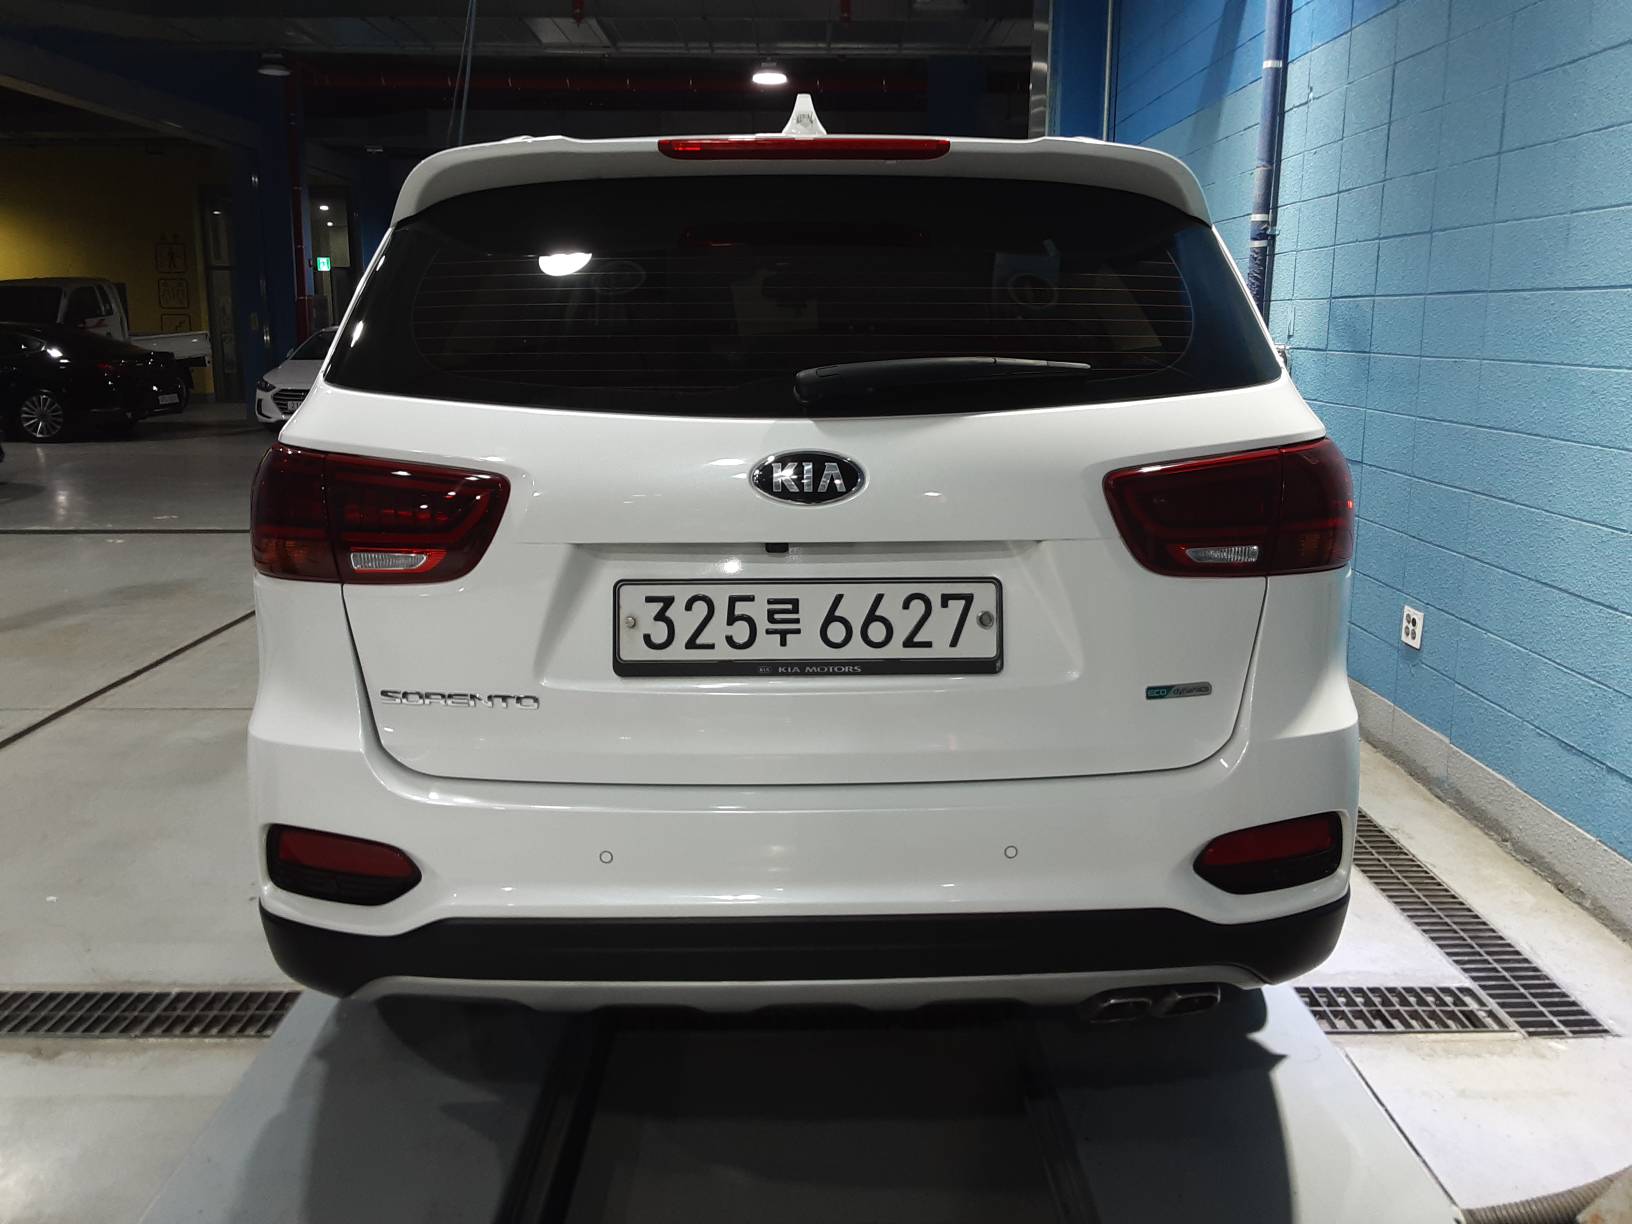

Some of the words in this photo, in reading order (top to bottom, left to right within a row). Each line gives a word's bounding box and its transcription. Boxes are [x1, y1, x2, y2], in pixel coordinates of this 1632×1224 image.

[771, 462, 846, 492] KIA
[819, 593, 975, 650] 6627
[804, 665, 862, 673] MOTORS
[380, 689, 540, 710] SORENTO
